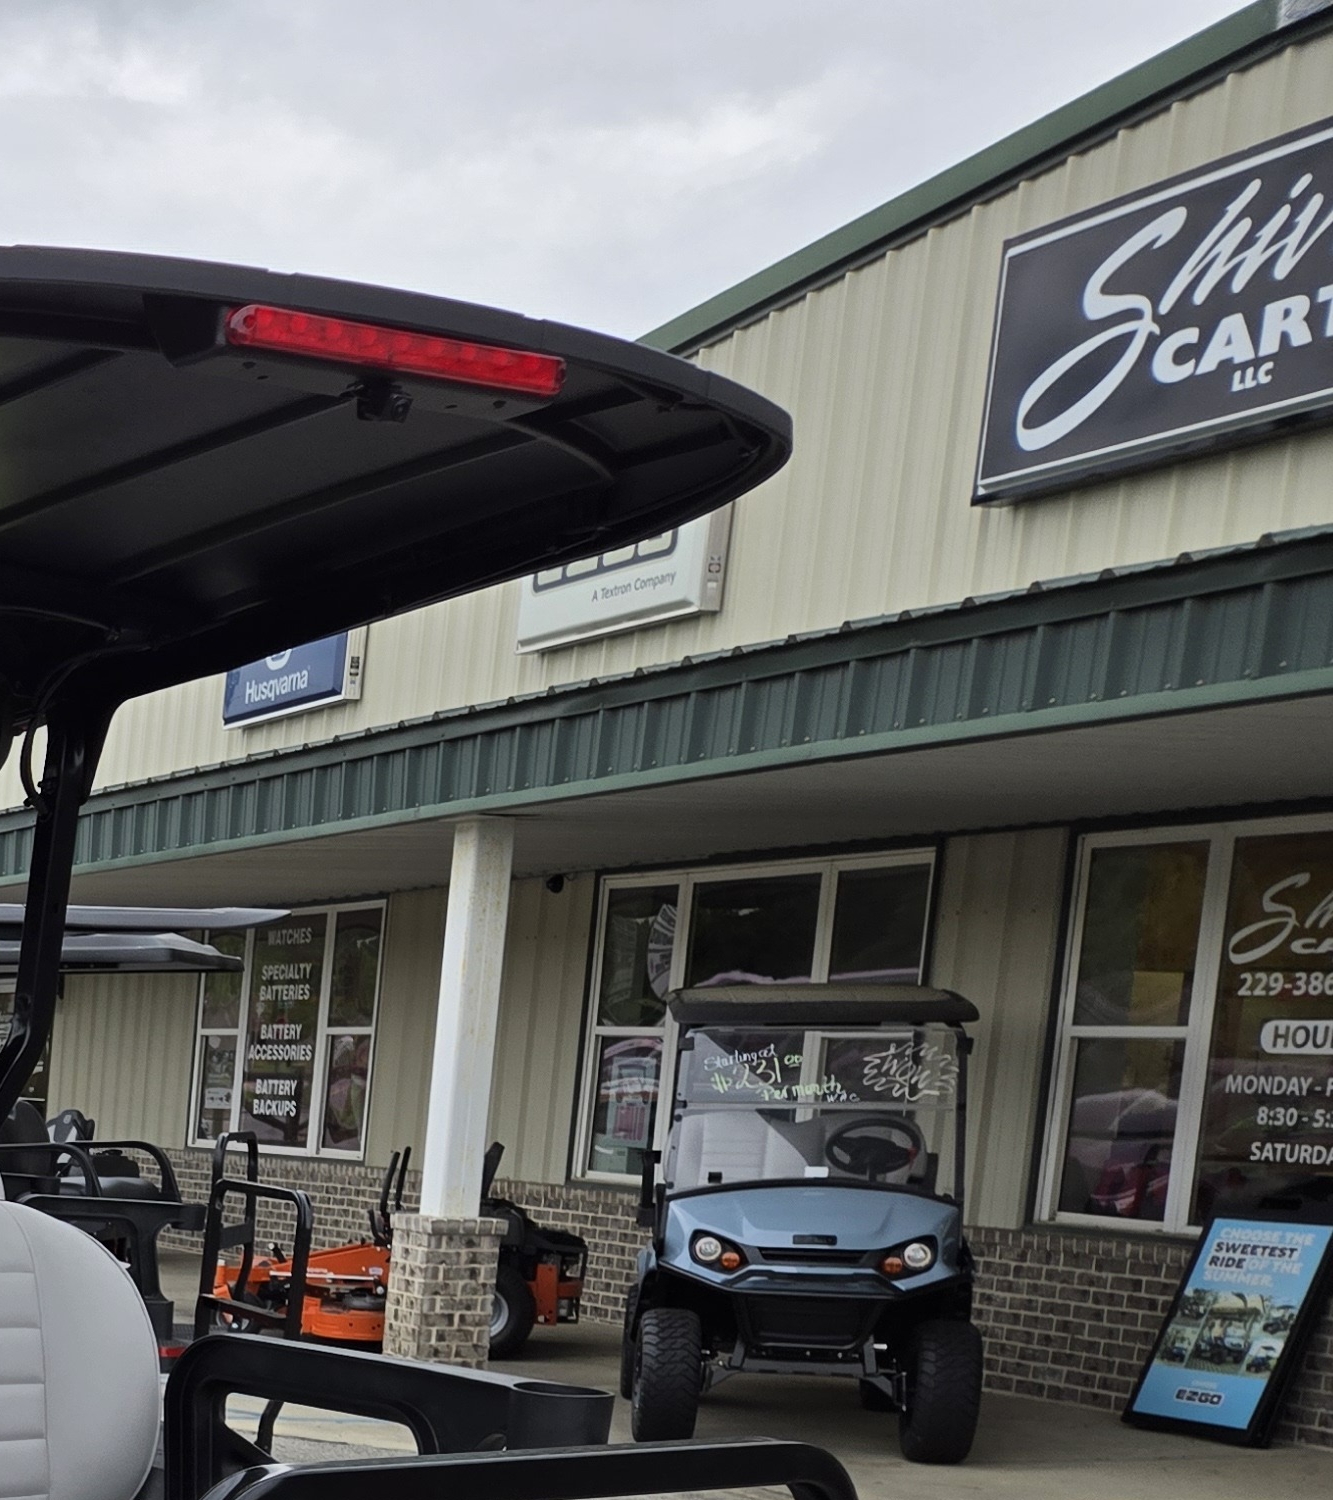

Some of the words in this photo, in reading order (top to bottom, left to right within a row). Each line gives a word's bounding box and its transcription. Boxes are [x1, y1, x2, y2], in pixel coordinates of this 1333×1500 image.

[1230, 361, 1274, 392] LLC
[592, 591, 598, 602] A
[601, 581, 631, 600] Textron
[634, 571, 676, 591] Company
[245, 669, 308, 704] Husqvarna
[268, 927, 312, 946] WATCHES
[261, 963, 312, 980] SPECIALTY
[260, 984, 311, 1001] BATTERIES
[260, 1024, 303, 1040] BATTERY
[1272, 1025, 1333, 1049] HOU
[248, 1044, 313, 1061] ACCESSORIES
[256, 1078, 298, 1096] BATTERY
[793, 1074, 846, 1097] month
[1225, 1074, 1312, 1096] MONDAY
[253, 1099, 297, 1117] BACKUPS
[1257, 1106, 1298, 1126] 8:30
[1219, 1227, 1282, 1242] CHOOSE
[1285, 1230, 1315, 1246] THE
[1215, 1241, 1298, 1258] SWEETEST
[1209, 1255, 1246, 1269] RIDE
[1247, 1258, 1270, 1270] OF
[1273, 1260, 1303, 1275] THE
[1176, 1389, 1222, 1405] EZGO
